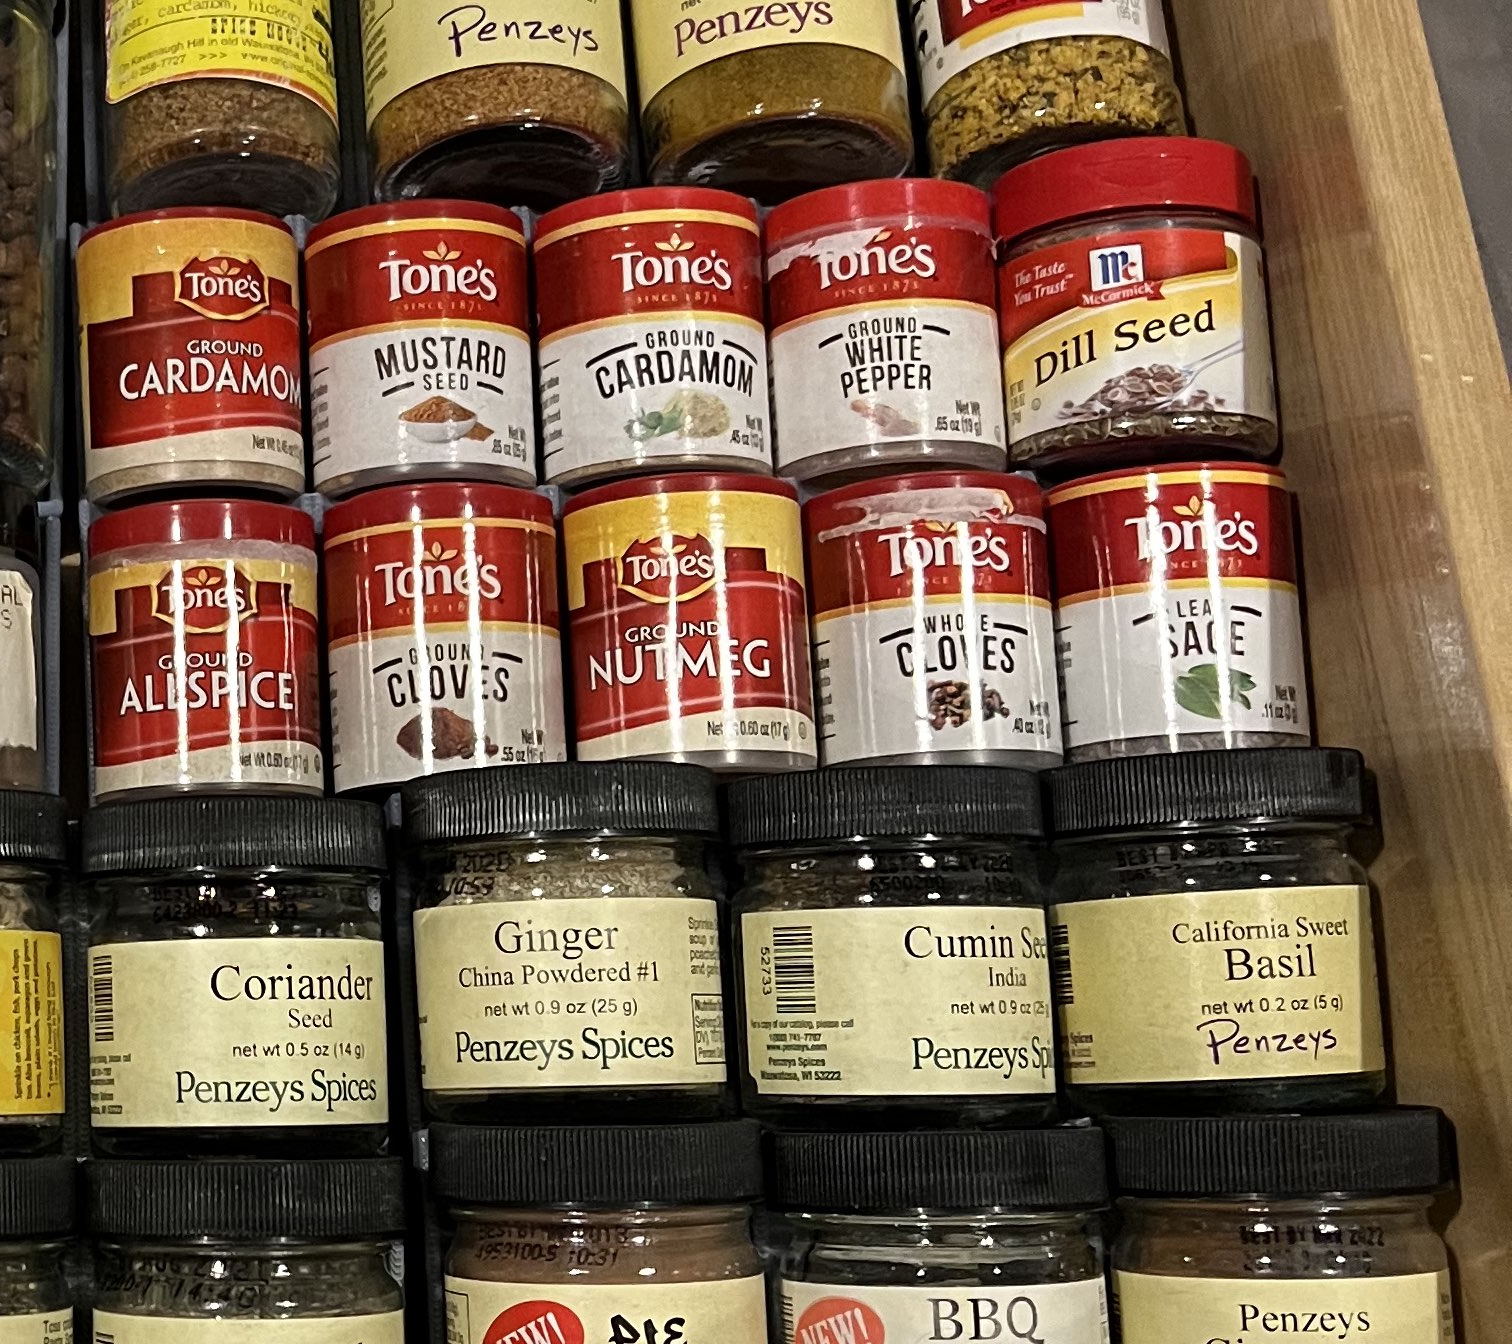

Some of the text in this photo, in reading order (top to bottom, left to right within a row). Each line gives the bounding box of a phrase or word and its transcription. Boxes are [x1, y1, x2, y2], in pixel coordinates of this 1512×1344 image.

[437, 4, 599, 58] Penzeys
[674, 0, 833, 58] Penzeys
[378, 259, 498, 302] Tone's
[610, 250, 732, 293] Tone's
[810, 236, 936, 290] Tone's
[184, 273, 262, 303] Tone's
[1081, 281, 1155, 307] McCormick
[187, 339, 263, 357] GROUND
[645, 329, 715, 349] GROUND
[848, 317, 917, 340] GROUND
[1034, 300, 1216, 388] Dill Seed
[374, 336, 506, 381] MUSTARD
[845, 335, 922, 368] WHITE
[119, 357, 302, 410] CARDAMOM
[423, 372, 469, 391] SEED
[595, 350, 754, 399] CARDAMOM
[840, 364, 932, 398] PEPPER
[589, 639, 771, 691] NUTMEG
[120, 671, 294, 716] ALLSPICE
[387, 664, 509, 708] CLOVES
[494, 919, 619, 960] Ginger
[904, 924, 1047, 959] Cumin See
[1172, 916, 1349, 944] California Sweet
[210, 963, 373, 1002] Coriander
[458, 961, 659, 988] China Powdered #1
[760, 946, 772, 996] 52733
[988, 966, 1027, 987] India
[1224, 943, 1316, 982] Basil
[287, 1008, 333, 1029] Seed
[1197, 1019, 1337, 1065] Penzeys
[175, 1070, 304, 1112] Penzeys
[311, 1069, 377, 1112] Spices
[1238, 1303, 1371, 1339] Penzeys
